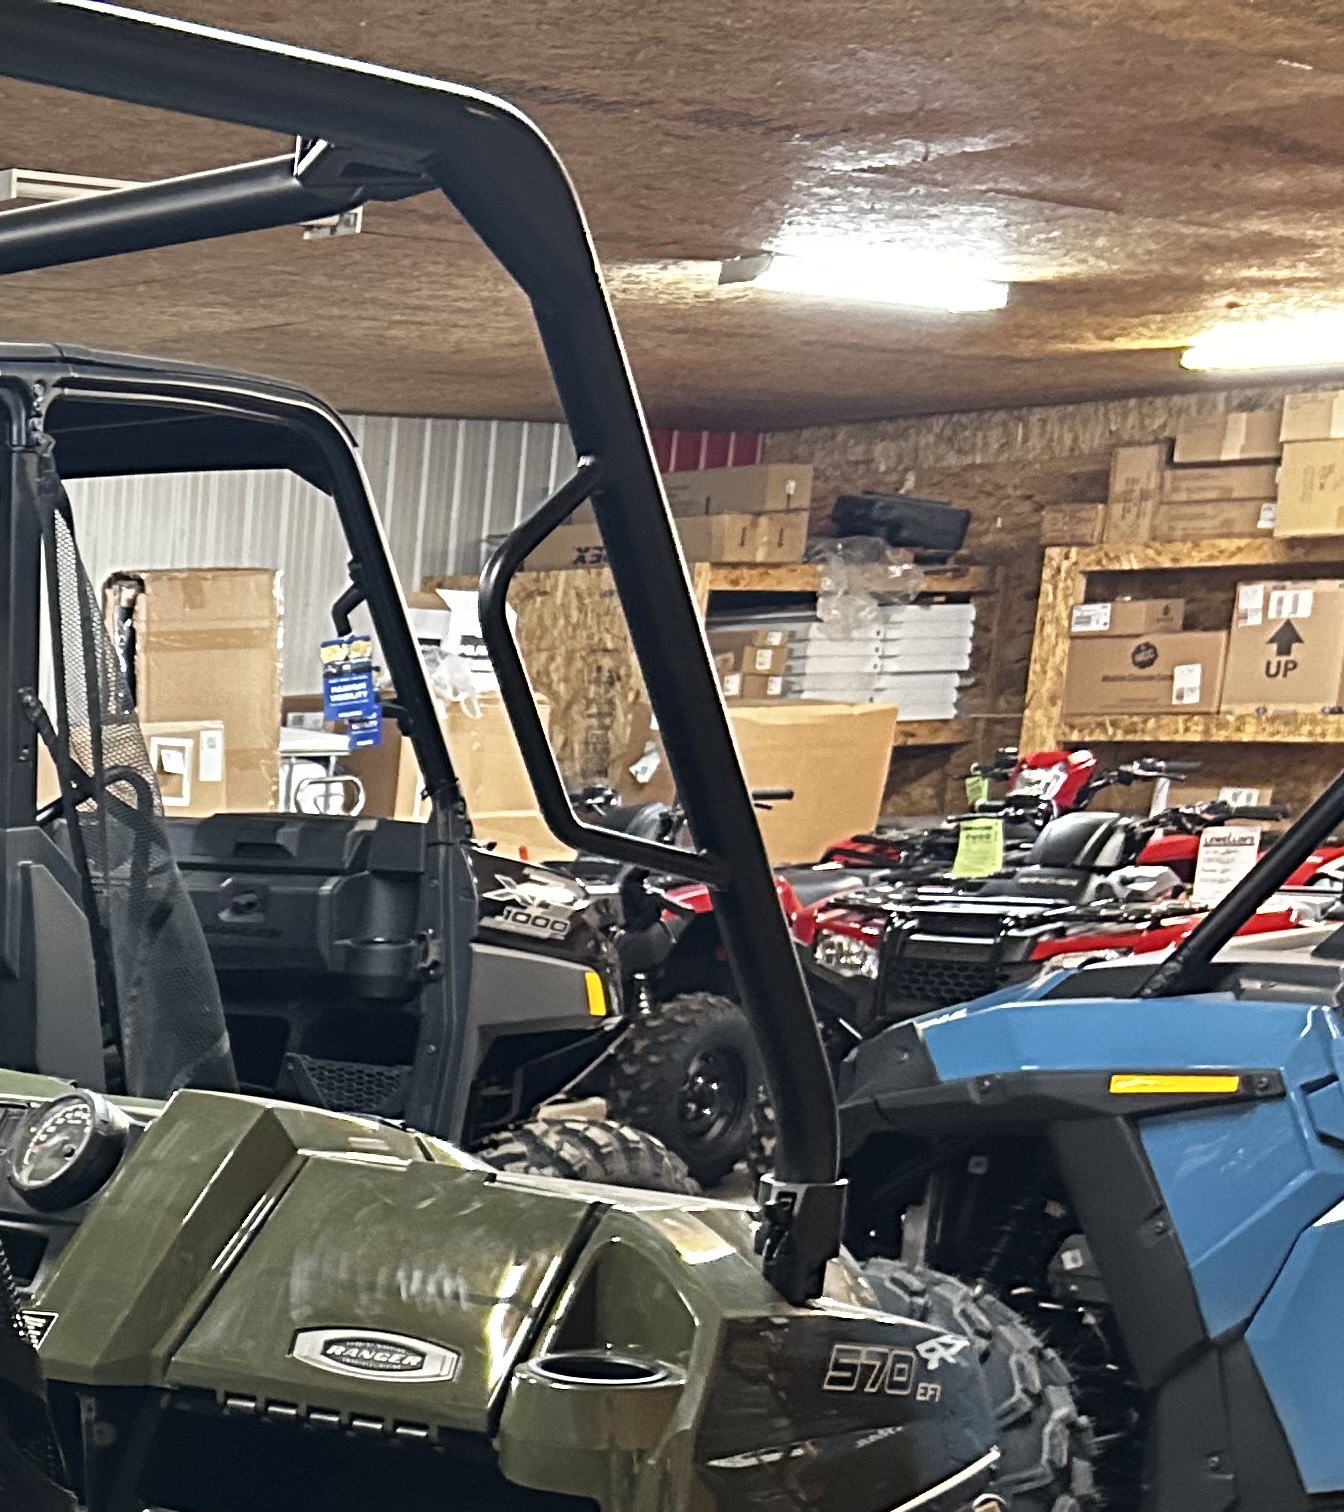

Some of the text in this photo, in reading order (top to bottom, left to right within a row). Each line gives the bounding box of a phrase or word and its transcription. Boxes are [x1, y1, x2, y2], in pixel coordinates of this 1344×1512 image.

[1265, 659, 1298, 678] UP
[326, 1344, 422, 1366] RANGER
[823, 1344, 942, 1402] 570 EFI
